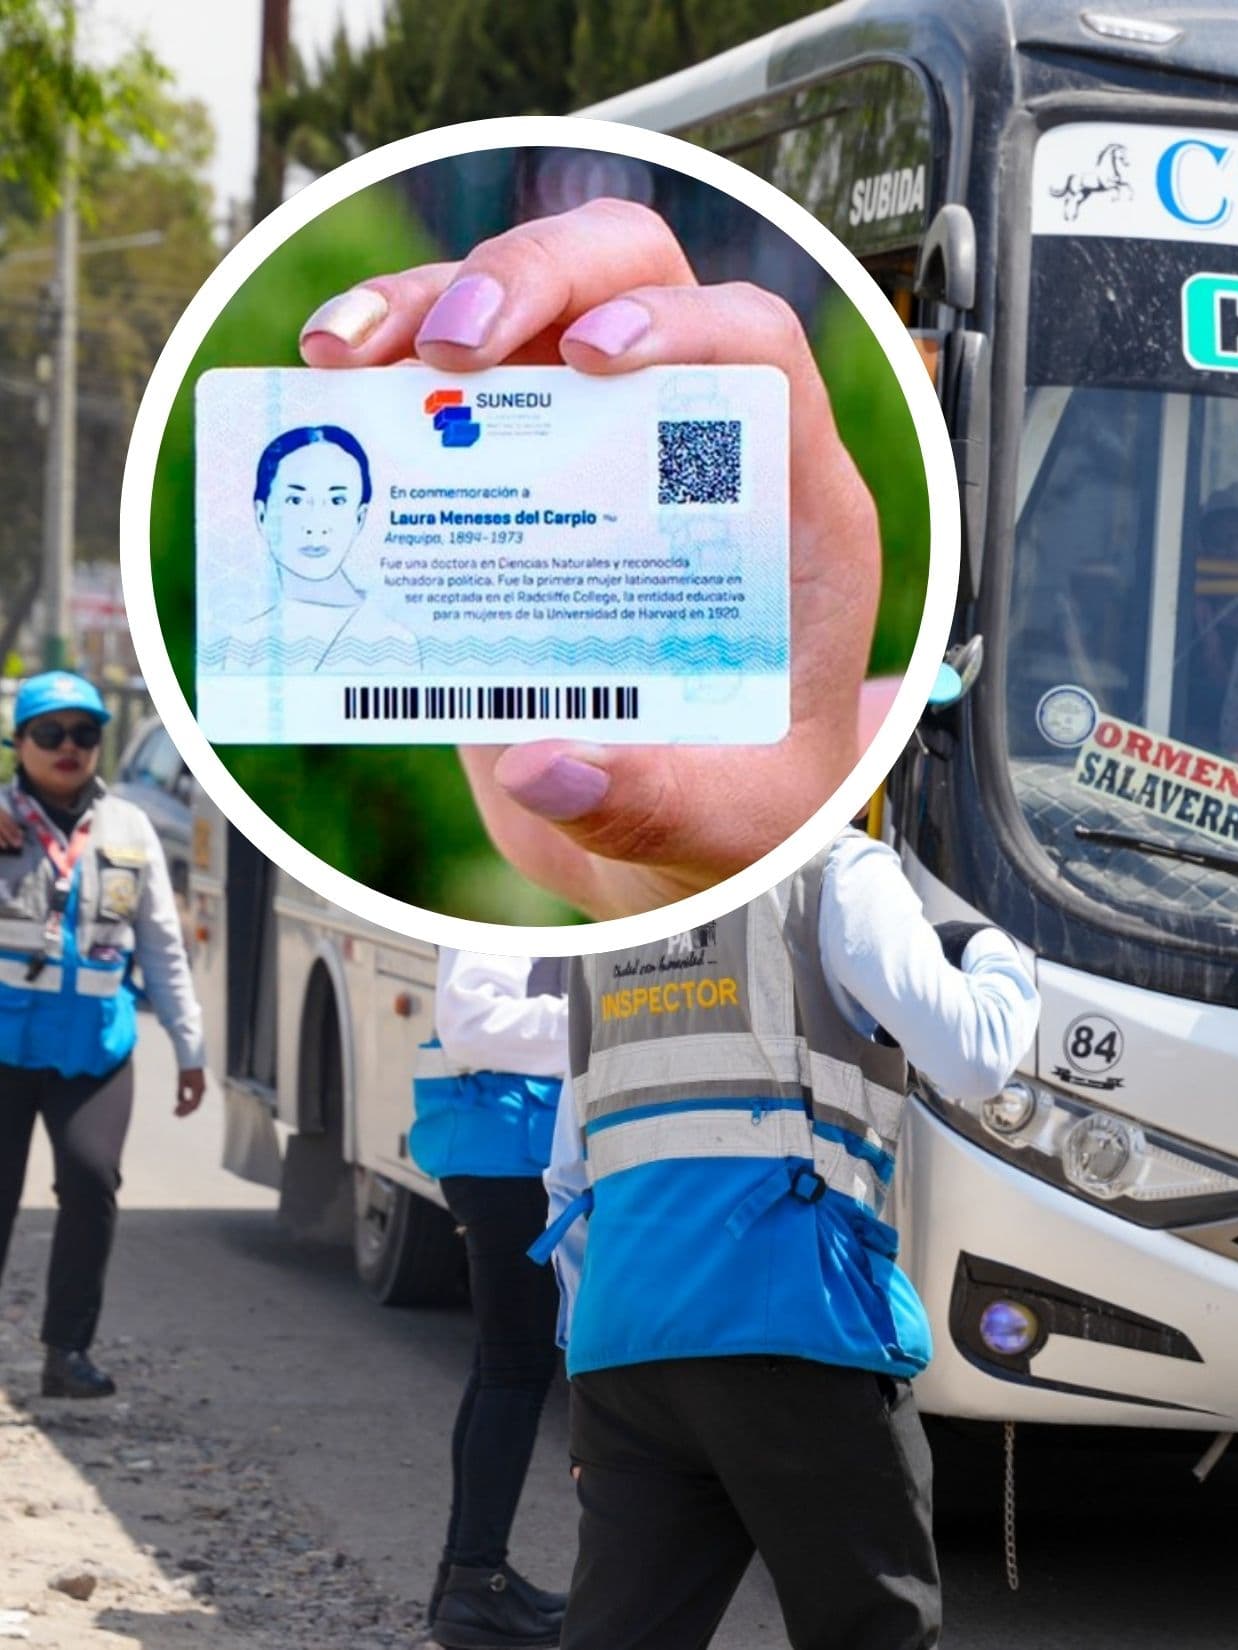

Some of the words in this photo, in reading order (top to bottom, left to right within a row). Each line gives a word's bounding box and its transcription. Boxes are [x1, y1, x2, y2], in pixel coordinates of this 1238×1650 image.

[850, 163, 926, 227] SUBIDA
[476, 392, 552, 408] SUNEDU
[390, 486, 406, 499] En
[409, 484, 518, 499] conmemoración
[522, 488, 530, 499] a
[390, 510, 436, 525] Laura
[515, 509, 539, 525] del
[544, 510, 597, 528] Carpio
[449, 531, 523, 545] 1894-1973
[380, 557, 402, 569] Fue
[405, 559, 427, 569] una
[431, 557, 477, 569] doctora
[480, 559, 496, 569] en
[498, 556, 549, 569] Ciencias
[552, 557, 610, 569] Naturales
[613, 559, 619, 571] y
[622, 557, 690, 569] reconocida
[384, 574, 444, 586] luchadora
[498, 574, 519, 586] Fue
[522, 574, 534, 586] la
[537, 574, 584, 588] primera
[587, 574, 622, 588] mujer
[625, 573, 724, 586] latinoamericana
[726, 575, 742, 586] en
[405, 592, 424, 603] ser
[427, 591, 482, 605] aceptada
[485, 593, 500, 603] en
[503, 591, 514, 603] el
[623, 590, 635, 603] la
[637, 590, 684, 603] entidad
[686, 590, 745, 603] educativa
[433, 609, 460, 621] para
[463, 608, 512, 622] mujeres
[515, 607, 530, 620] de
[533, 607, 544, 620] la
[546, 607, 617, 620] Universidad
[620, 606, 635, 619] de
[638, 607, 686, 620] Harvard
[689, 608, 705, 619] en
[602, 977, 738, 1021] INSPECTOR
[1071, 1025, 1117, 1063] 84
